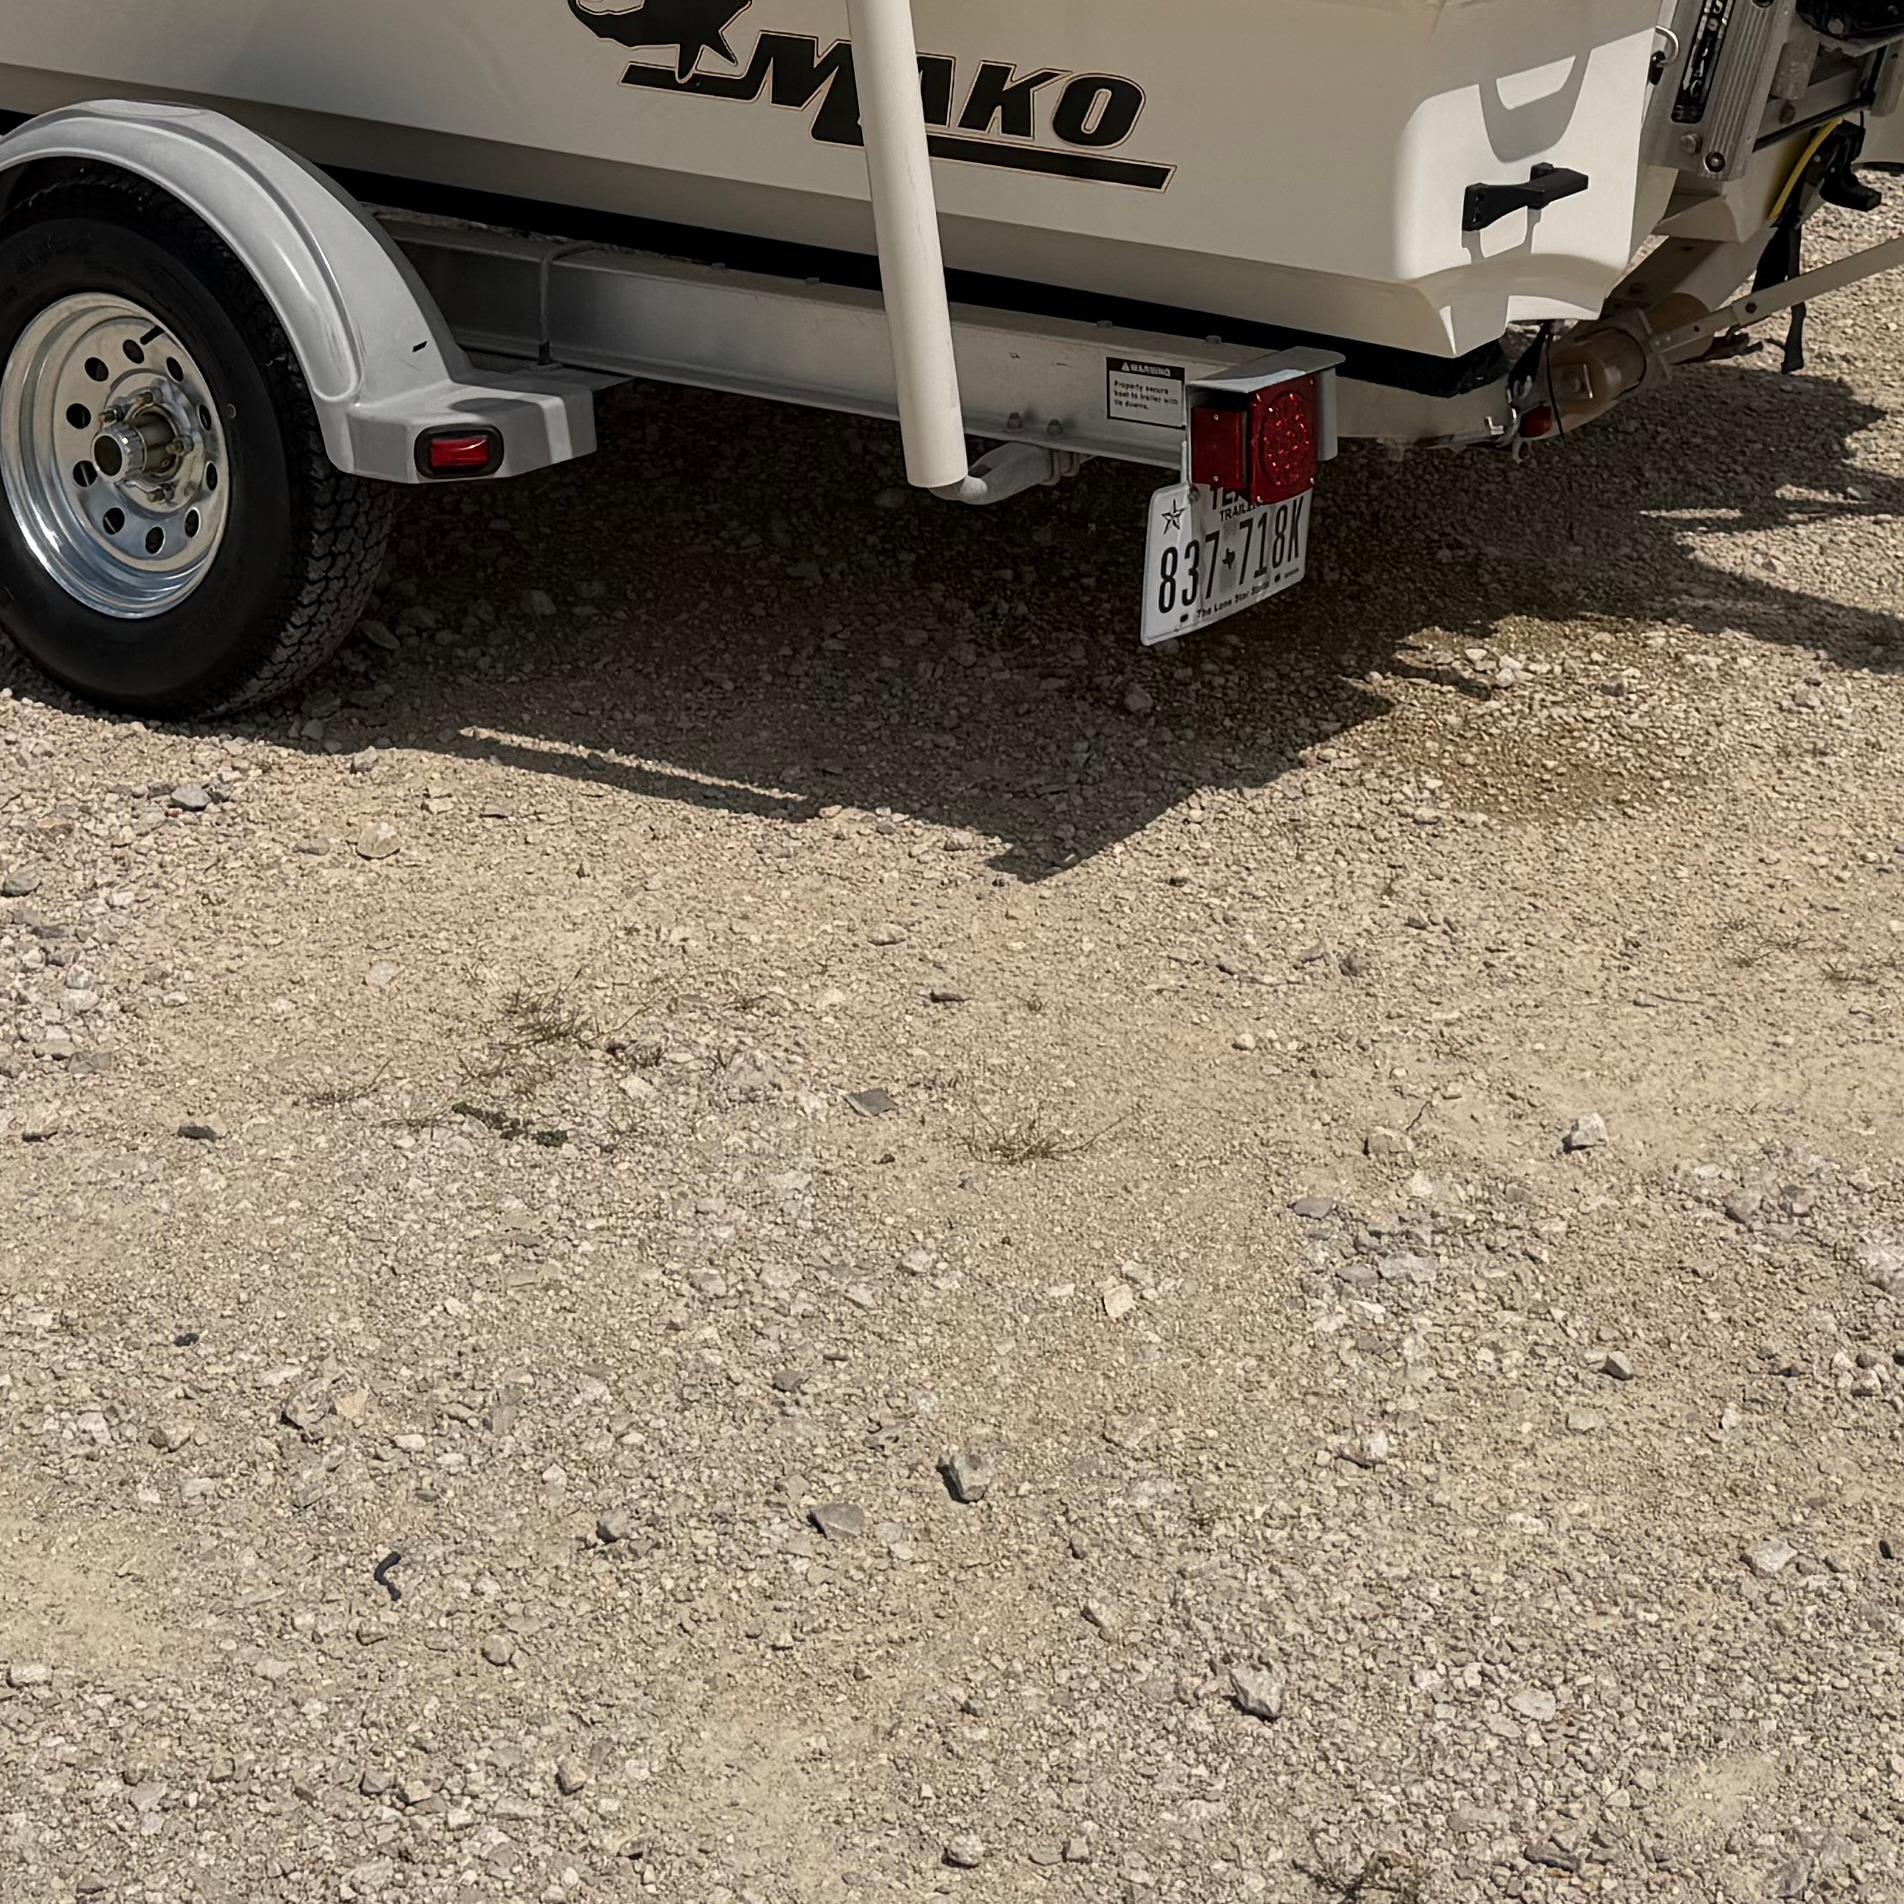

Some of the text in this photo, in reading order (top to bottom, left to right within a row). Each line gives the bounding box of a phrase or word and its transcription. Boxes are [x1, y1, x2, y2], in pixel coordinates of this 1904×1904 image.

[1130, 363, 1171, 377] WARNING
[1219, 503, 1257, 522] TRAIL
[1158, 496, 1304, 614] 837 718K
[1214, 599, 1233, 612] Lone
